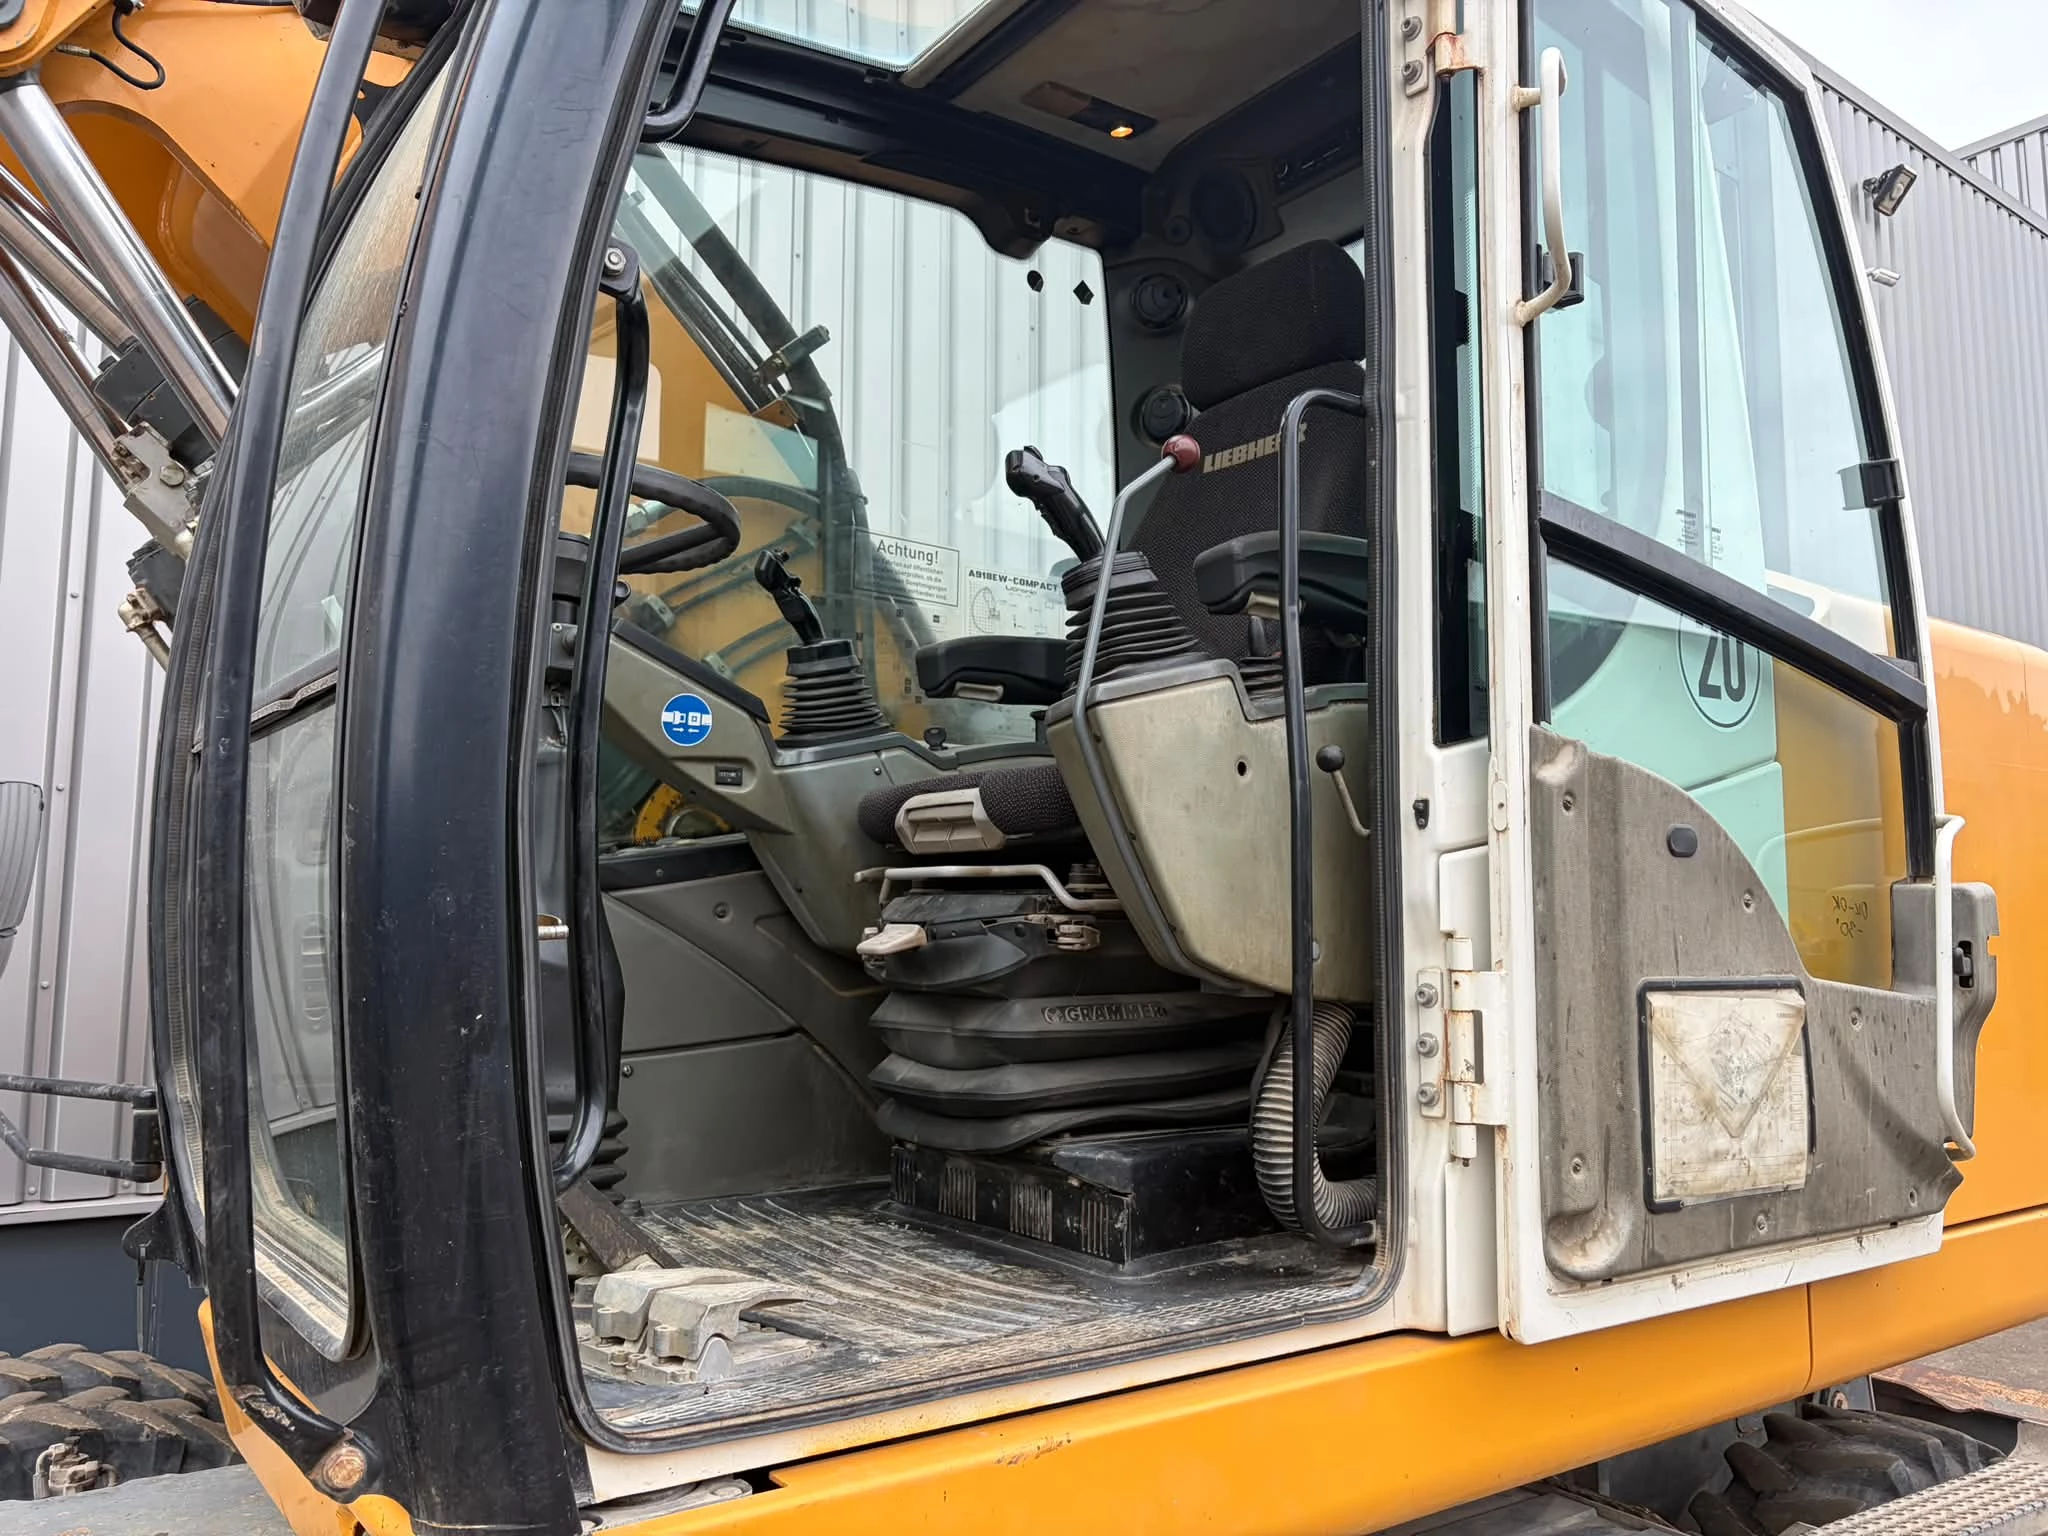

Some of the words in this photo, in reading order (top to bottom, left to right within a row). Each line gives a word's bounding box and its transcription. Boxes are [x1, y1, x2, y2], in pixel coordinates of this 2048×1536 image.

[1203, 422, 1307, 474] LIEBHE
[877, 540, 939, 566] Achtung!
[1696, 620, 1747, 702] 20
